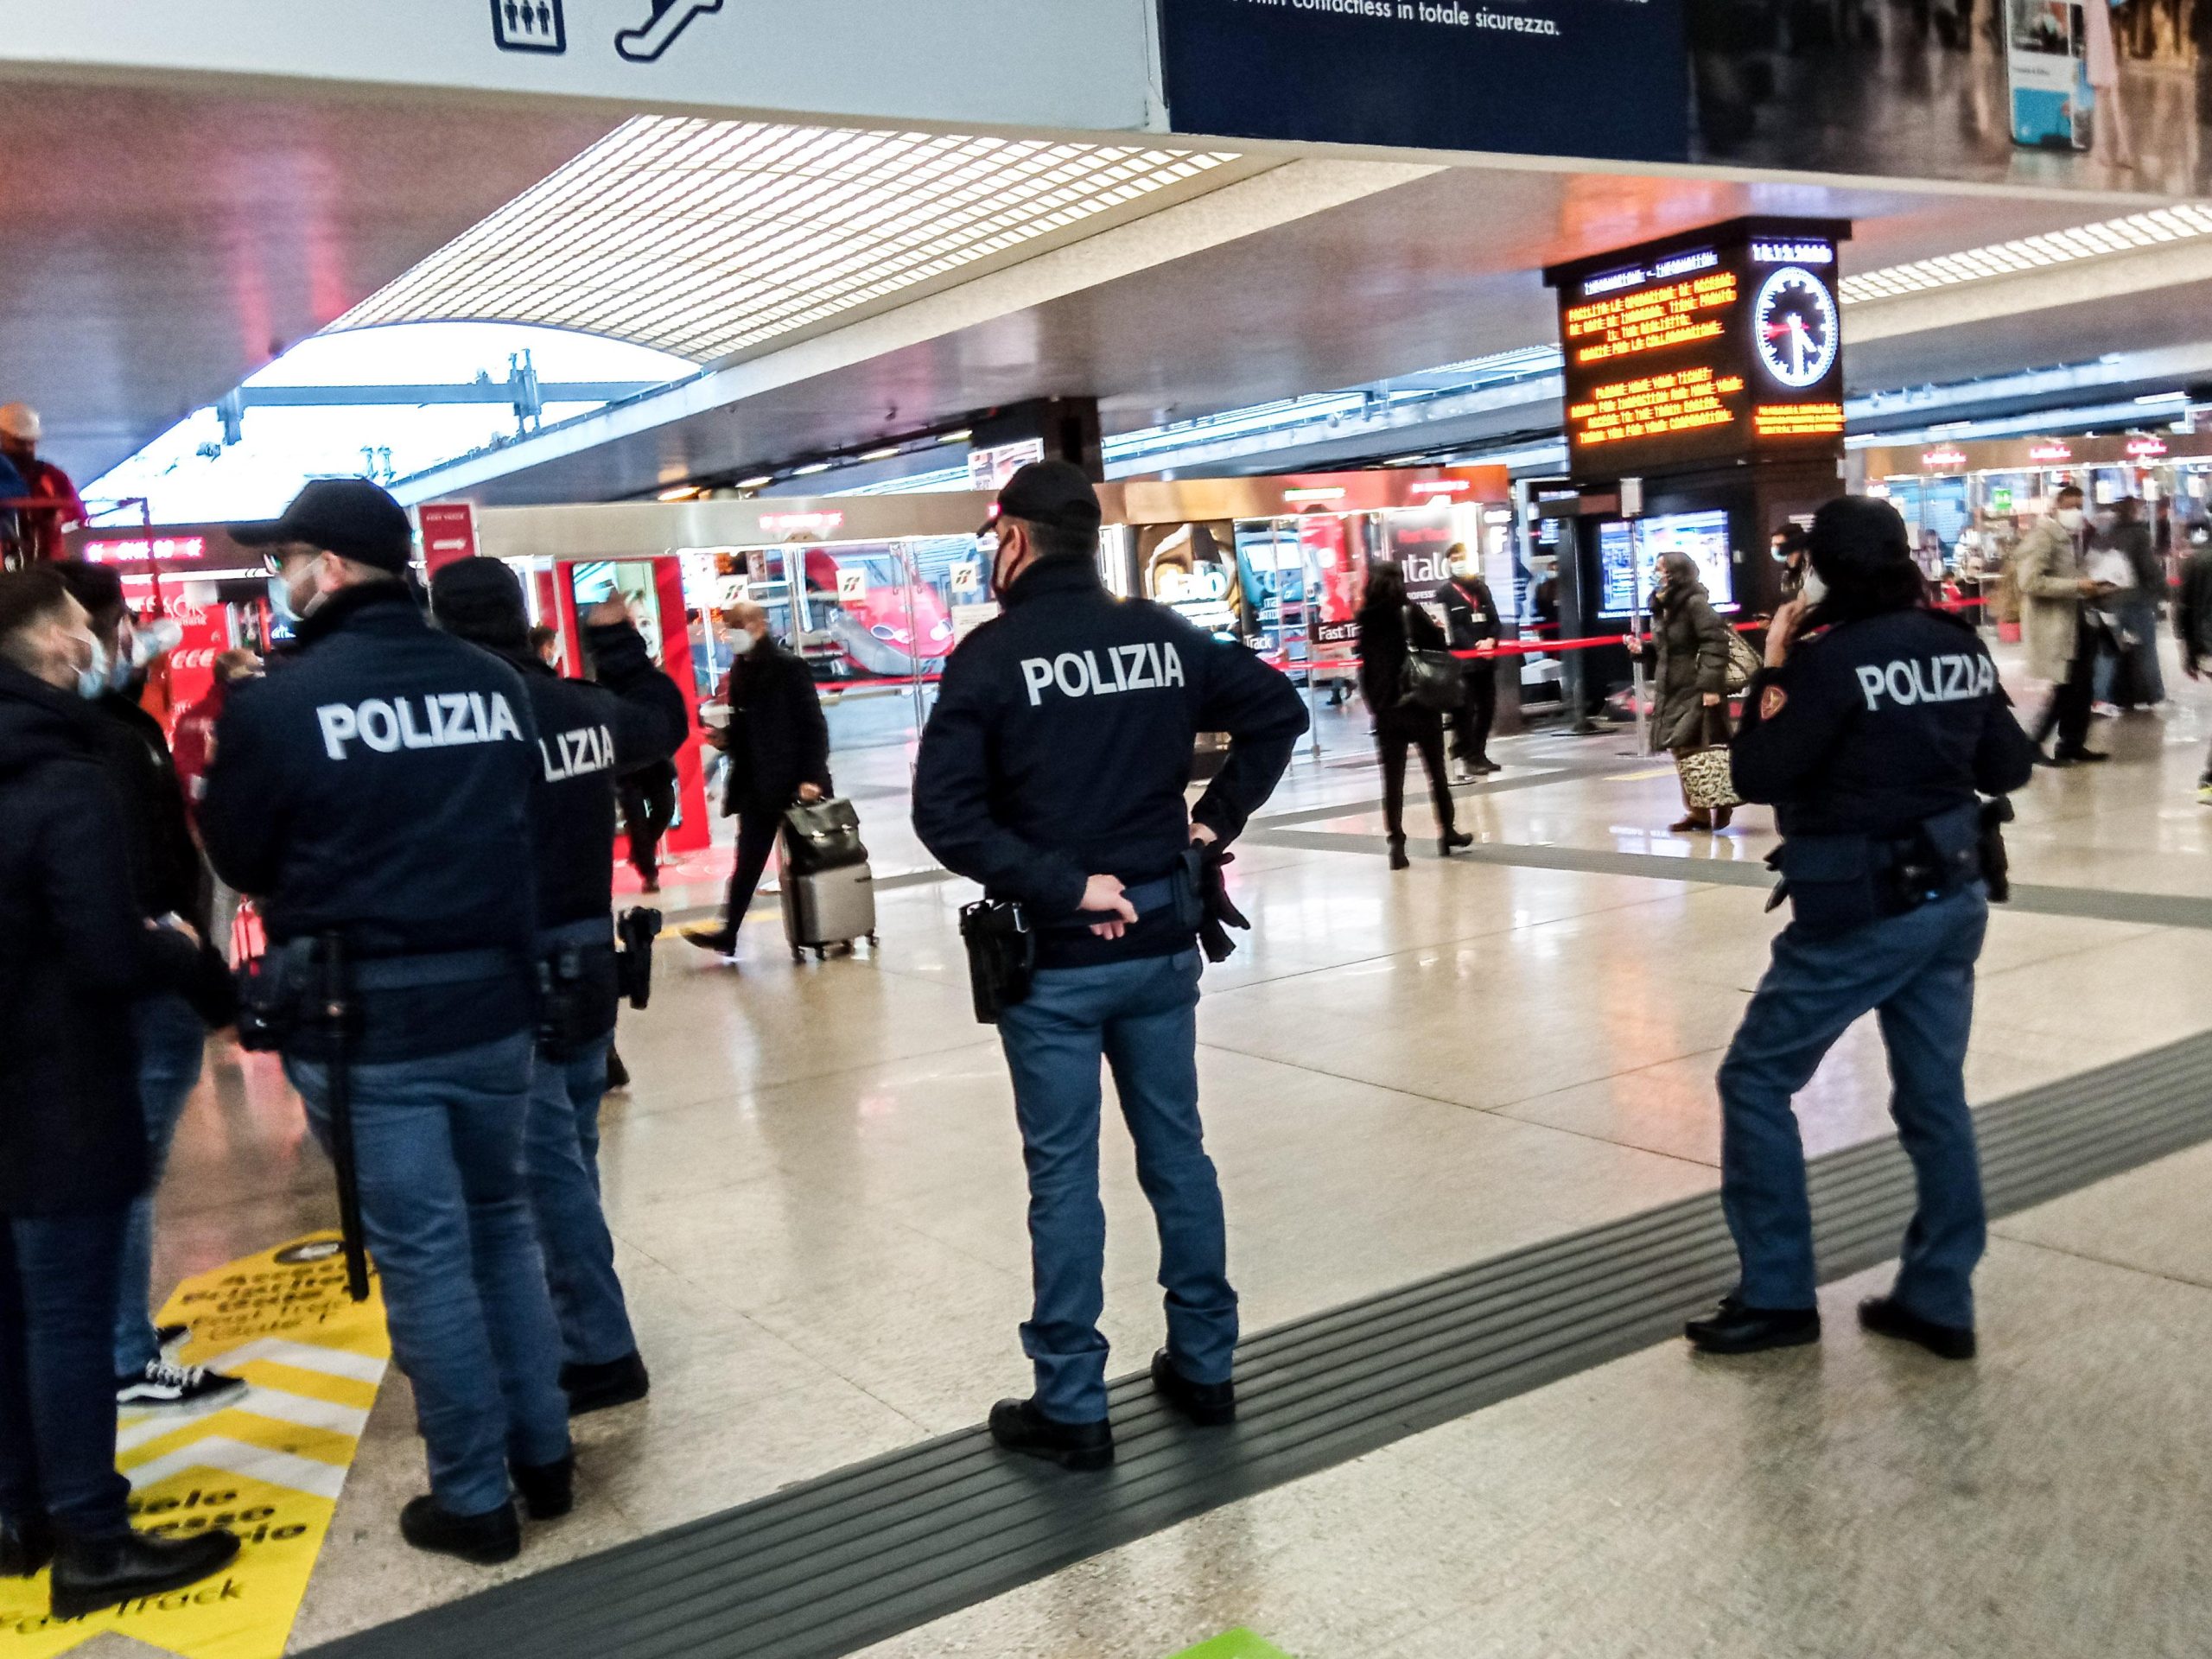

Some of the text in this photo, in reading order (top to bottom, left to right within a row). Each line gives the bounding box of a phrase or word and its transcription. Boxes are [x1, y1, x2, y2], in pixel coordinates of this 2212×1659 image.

[1397, 0, 1414, 21] in
[1418, 2, 1470, 27] totale
[1475, 7, 1561, 35] sicurezza.
[1319, 626, 1344, 640] Fast
[1020, 642, 1185, 706] POLIZIA
[1855, 653, 1999, 711] POLIZIA
[316, 691, 524, 760] POLIZIA
[537, 725, 616, 782] LIZIA
